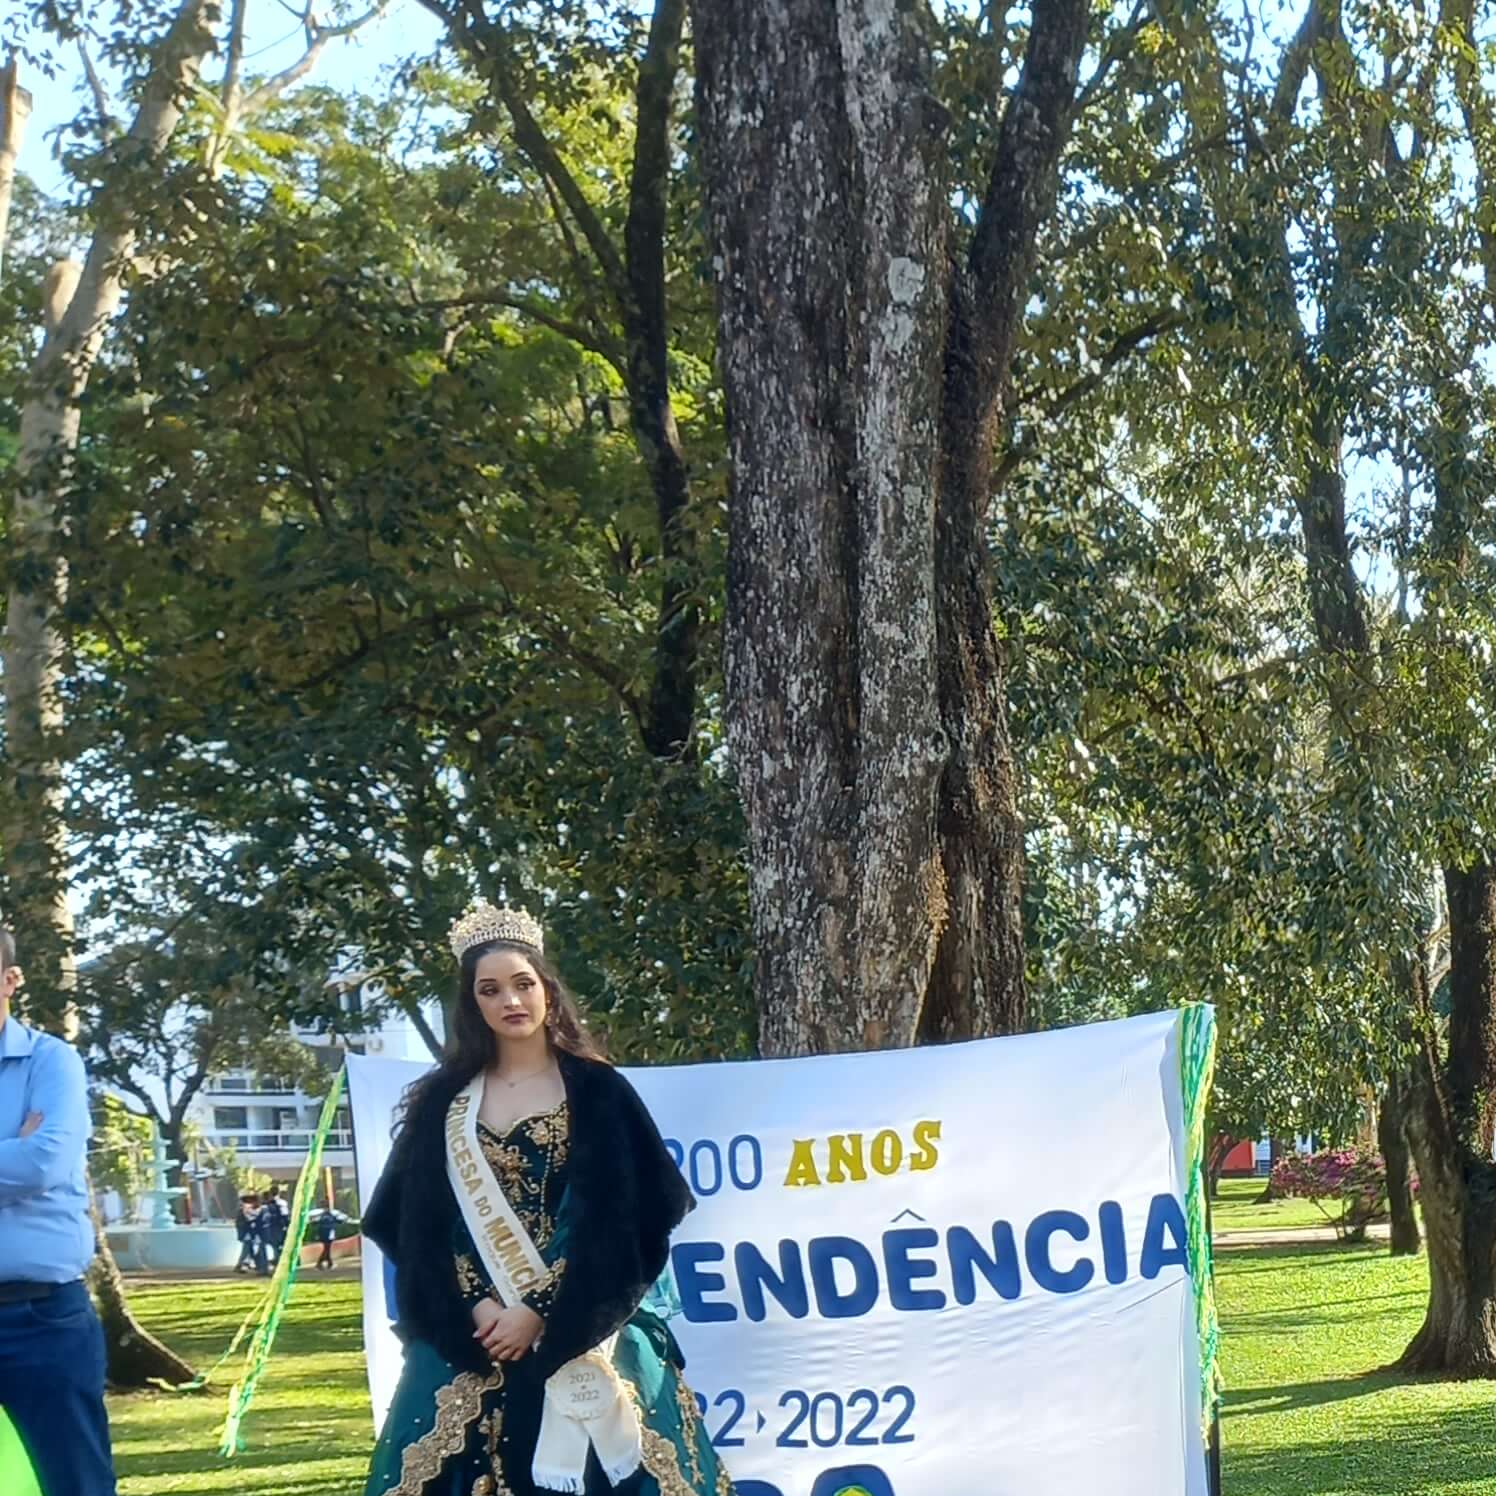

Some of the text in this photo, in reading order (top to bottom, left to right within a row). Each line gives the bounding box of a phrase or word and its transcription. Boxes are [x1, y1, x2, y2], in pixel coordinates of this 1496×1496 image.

[447, 1095, 483, 1195] PRINCESA
[474, 1196, 493, 1217] DO
[783, 1121, 942, 1186] ANOS
[776, 1385, 916, 1448] 2022
